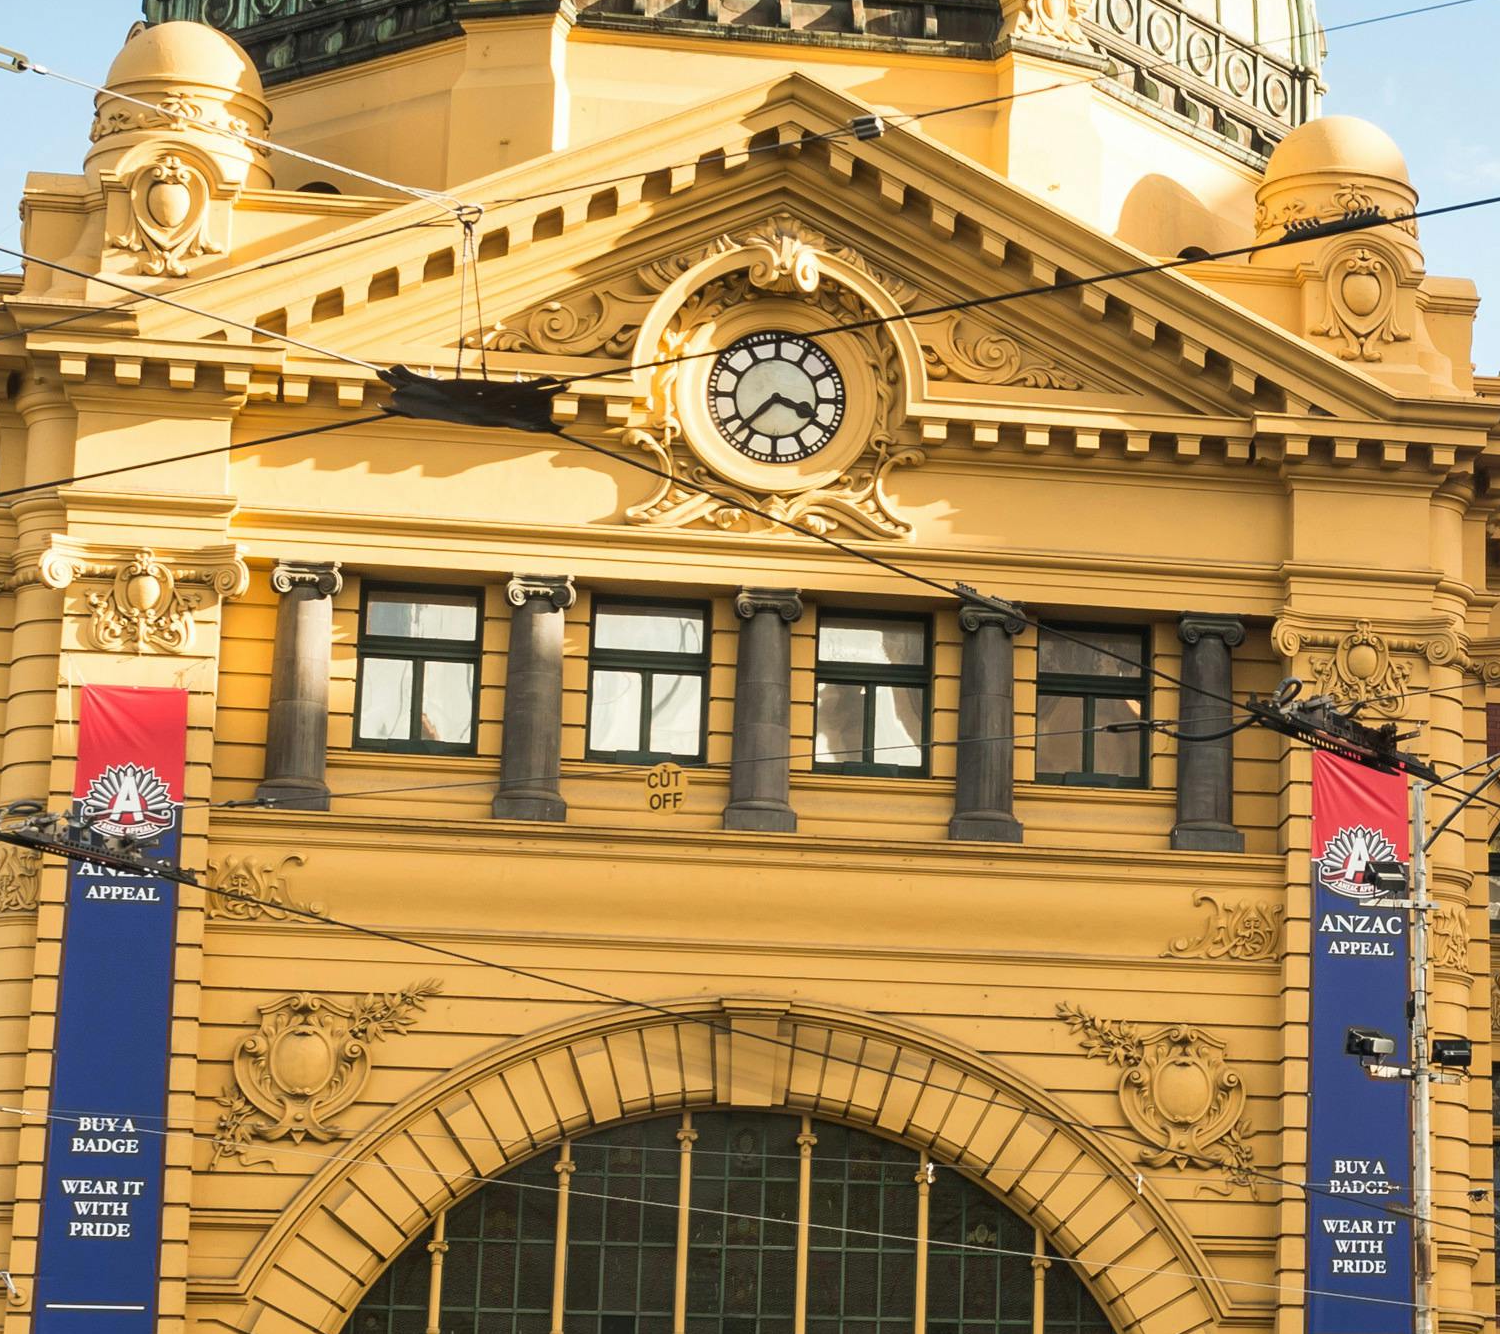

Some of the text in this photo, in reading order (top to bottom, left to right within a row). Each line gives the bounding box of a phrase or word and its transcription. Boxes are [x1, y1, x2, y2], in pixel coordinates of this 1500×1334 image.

[647, 771, 682, 789] CUT
[649, 792, 683, 810] OFF
[85, 885, 160, 901] APPEAL
[1318, 914, 1403, 935] ANZAC
[1328, 941, 1395, 956] APPEAL
[78, 1116, 136, 1132] BUY A
[71, 1137, 139, 1153] BADGE
[1334, 1160, 1386, 1175] BUY A
[61, 1179, 145, 1196] WEAR IT
[1329, 1179, 1390, 1194] BADGE
[73, 1201, 129, 1216] WITH
[69, 1222, 131, 1237] PRIDE
[1322, 1219, 1396, 1234] WEAR IT
[1334, 1239, 1384, 1254] WITH
[1332, 1259, 1387, 1274] PRIDE
